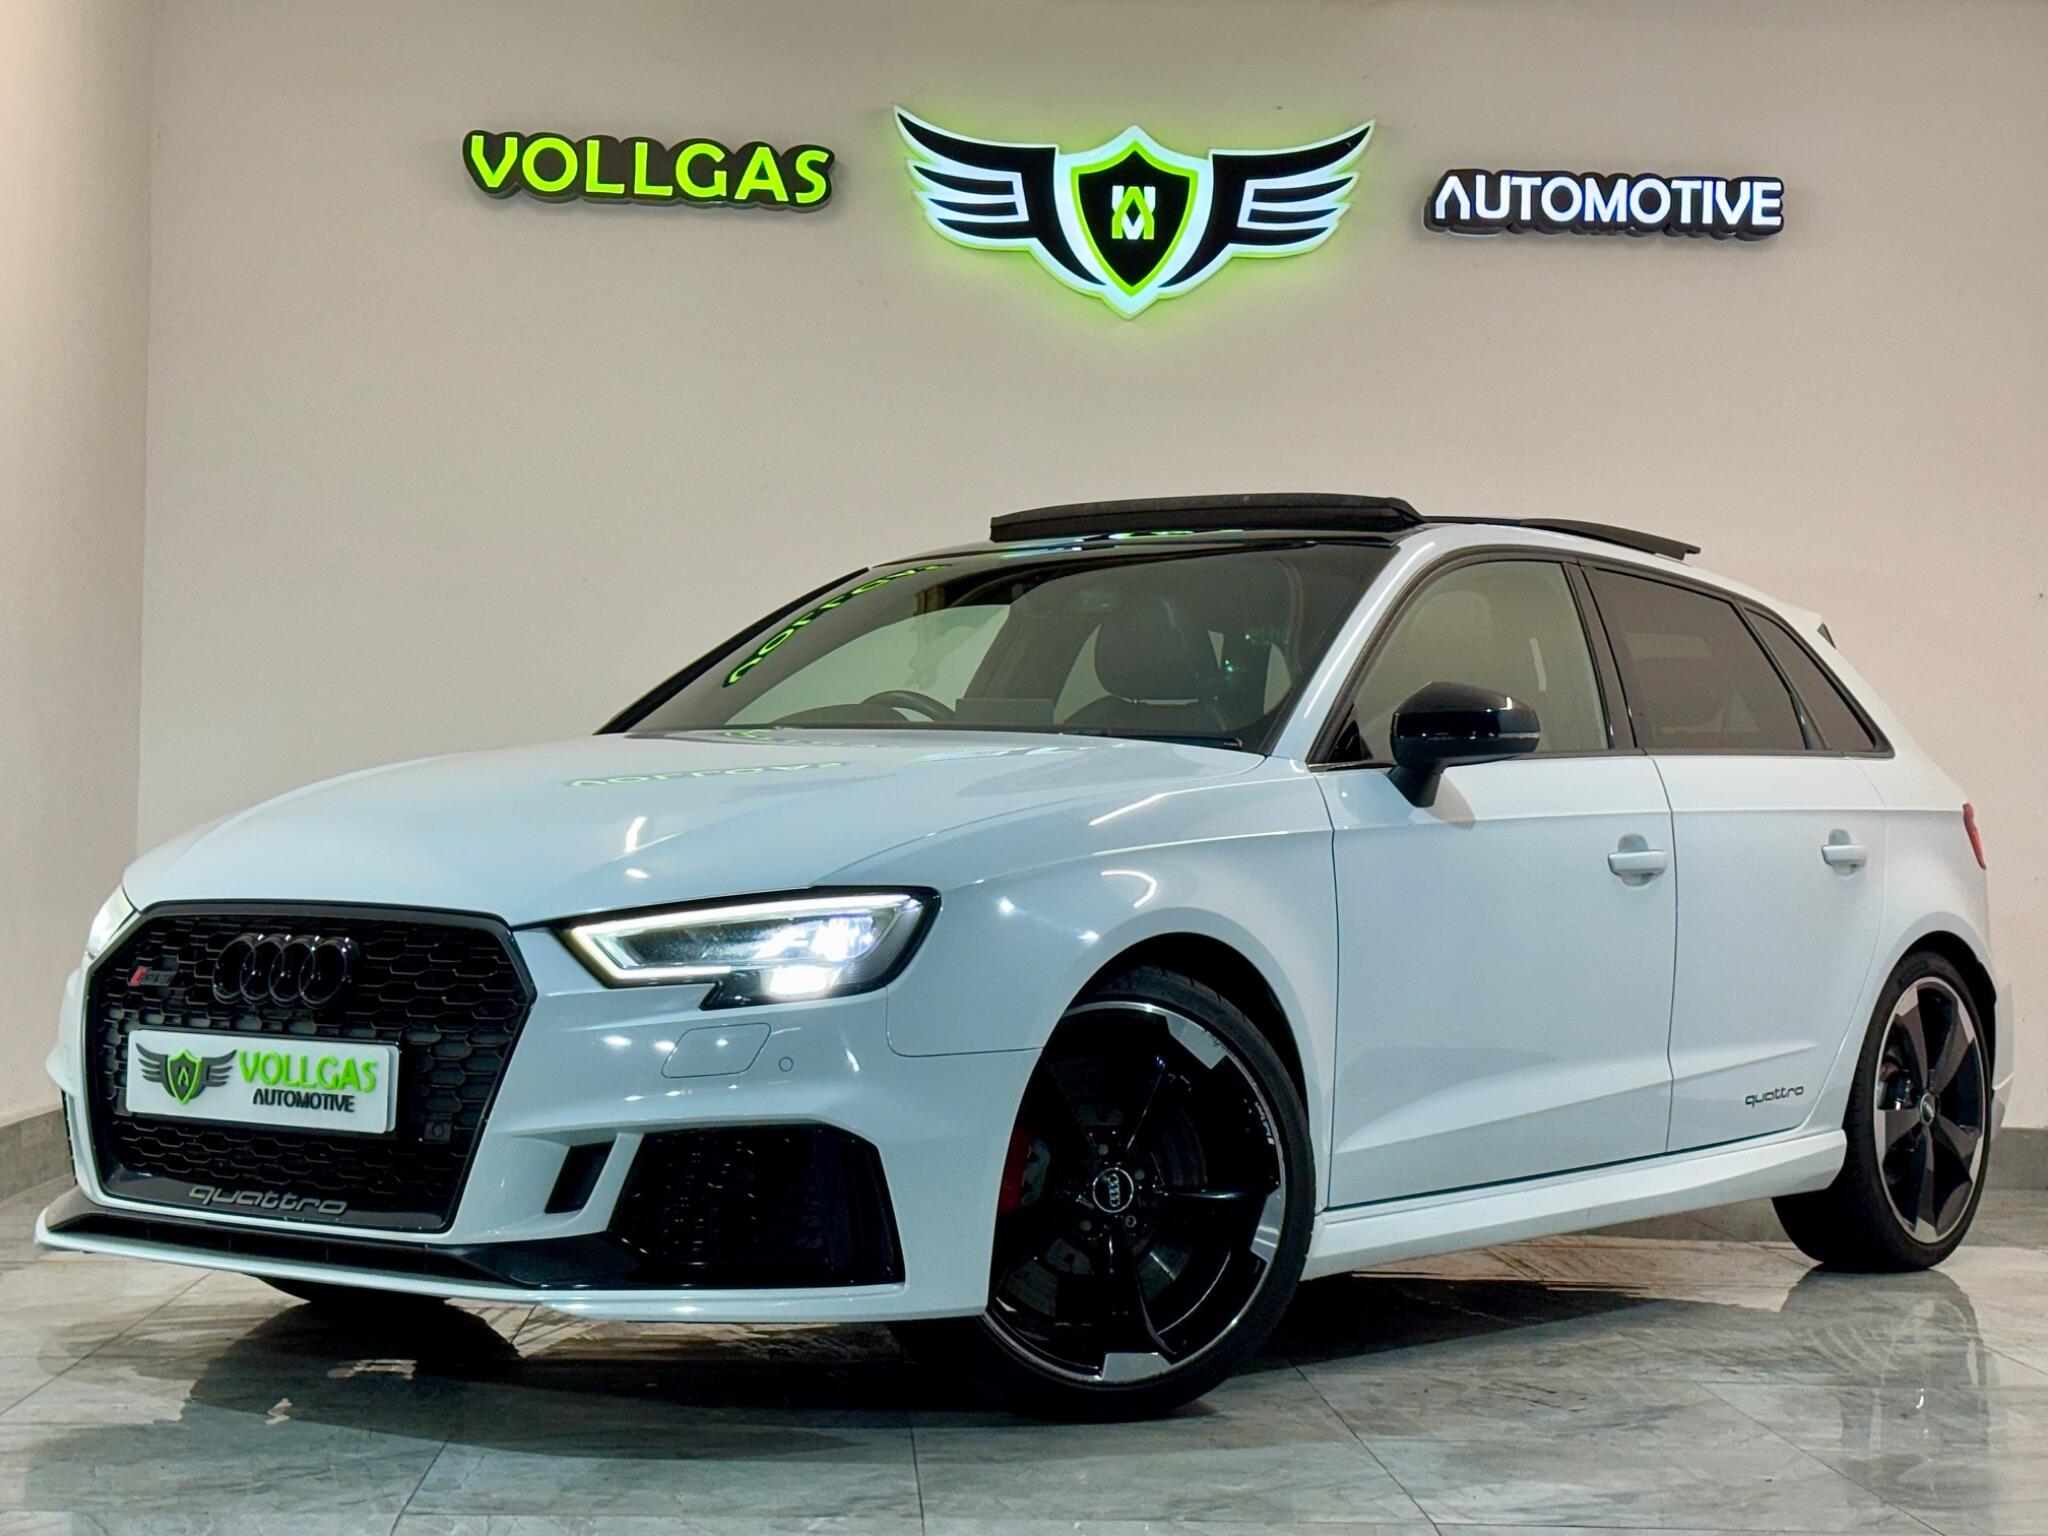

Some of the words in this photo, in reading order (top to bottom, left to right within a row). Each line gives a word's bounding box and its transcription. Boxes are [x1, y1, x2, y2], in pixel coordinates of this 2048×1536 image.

[470, 135, 830, 204] VOLLGAS
[1435, 174, 1782, 226] AUTOMOTIVE
[238, 1050, 377, 1093] VOLLGAS
[253, 1088, 355, 1113] AUTOMOTIVE
[1744, 1085, 1805, 1108] quattro
[188, 1184, 348, 1216] quattro
